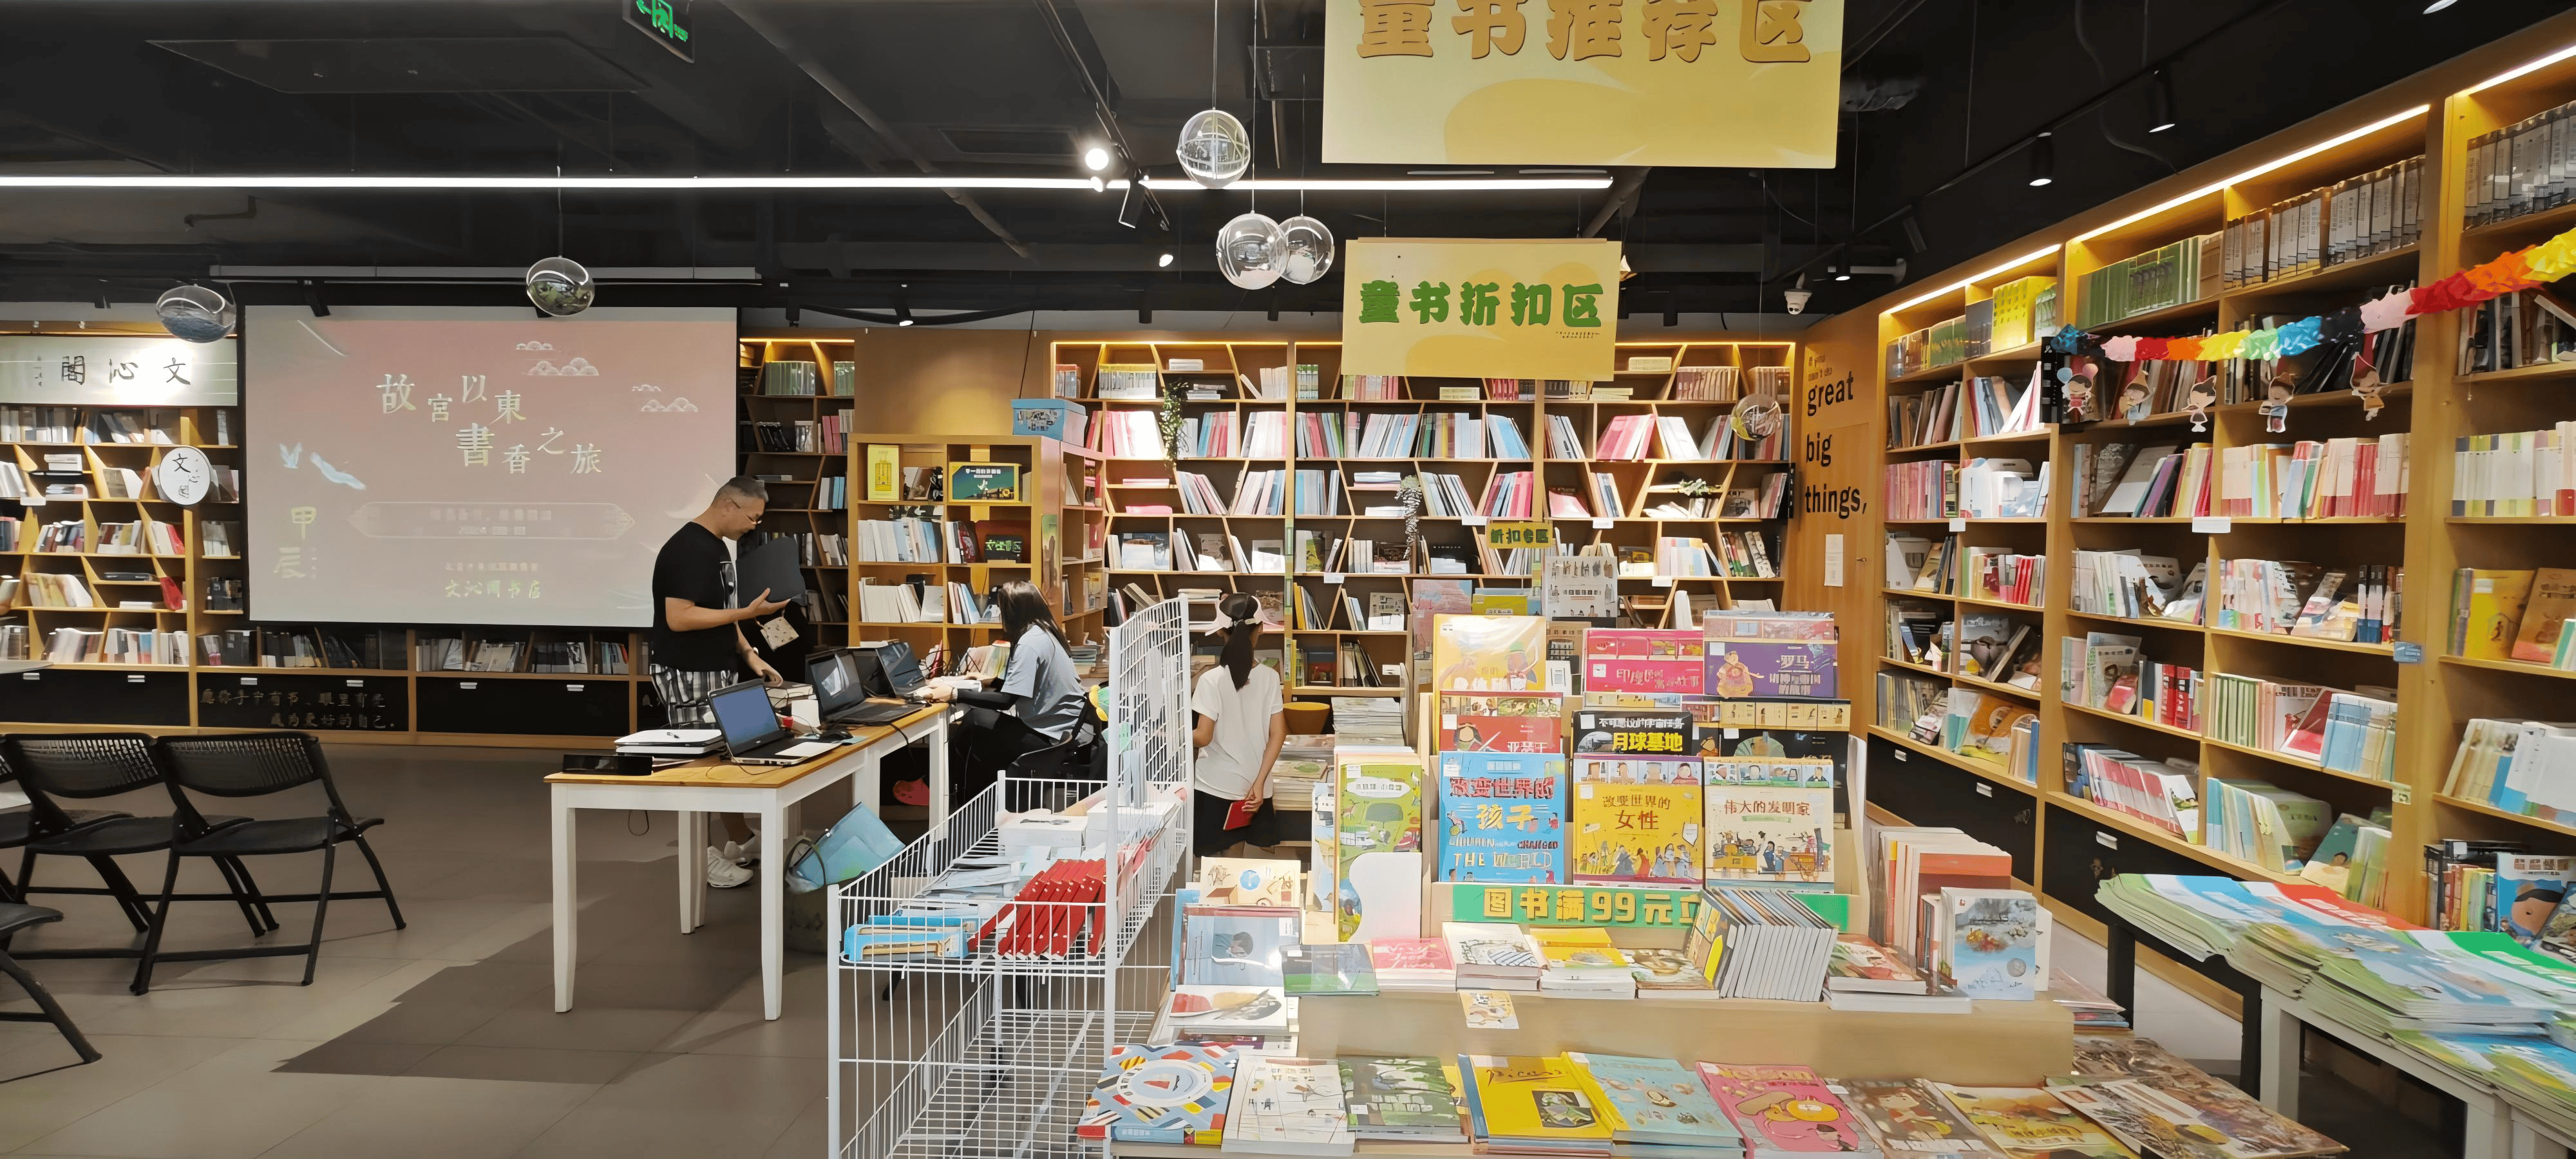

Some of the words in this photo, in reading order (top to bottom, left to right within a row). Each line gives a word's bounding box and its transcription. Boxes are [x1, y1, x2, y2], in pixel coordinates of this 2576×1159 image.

[1359, 279, 1603, 328] 童书折扣区
[1807, 371, 1854, 417] great
[1806, 432, 1832, 467] big
[1804, 483, 1867, 519] things,
[1612, 731, 1683, 752] 月球基地
[1450, 777, 1556, 799] 改变世界的
[1602, 793, 1672, 809] 改变世界的
[1723, 799, 1810, 816] 伟大的发明家
[1476, 804, 1535, 831] 孩子
[1615, 809, 1660, 830] 女性
[1453, 851, 1486, 867] THE
[1492, 850, 1553, 869] WORLD
